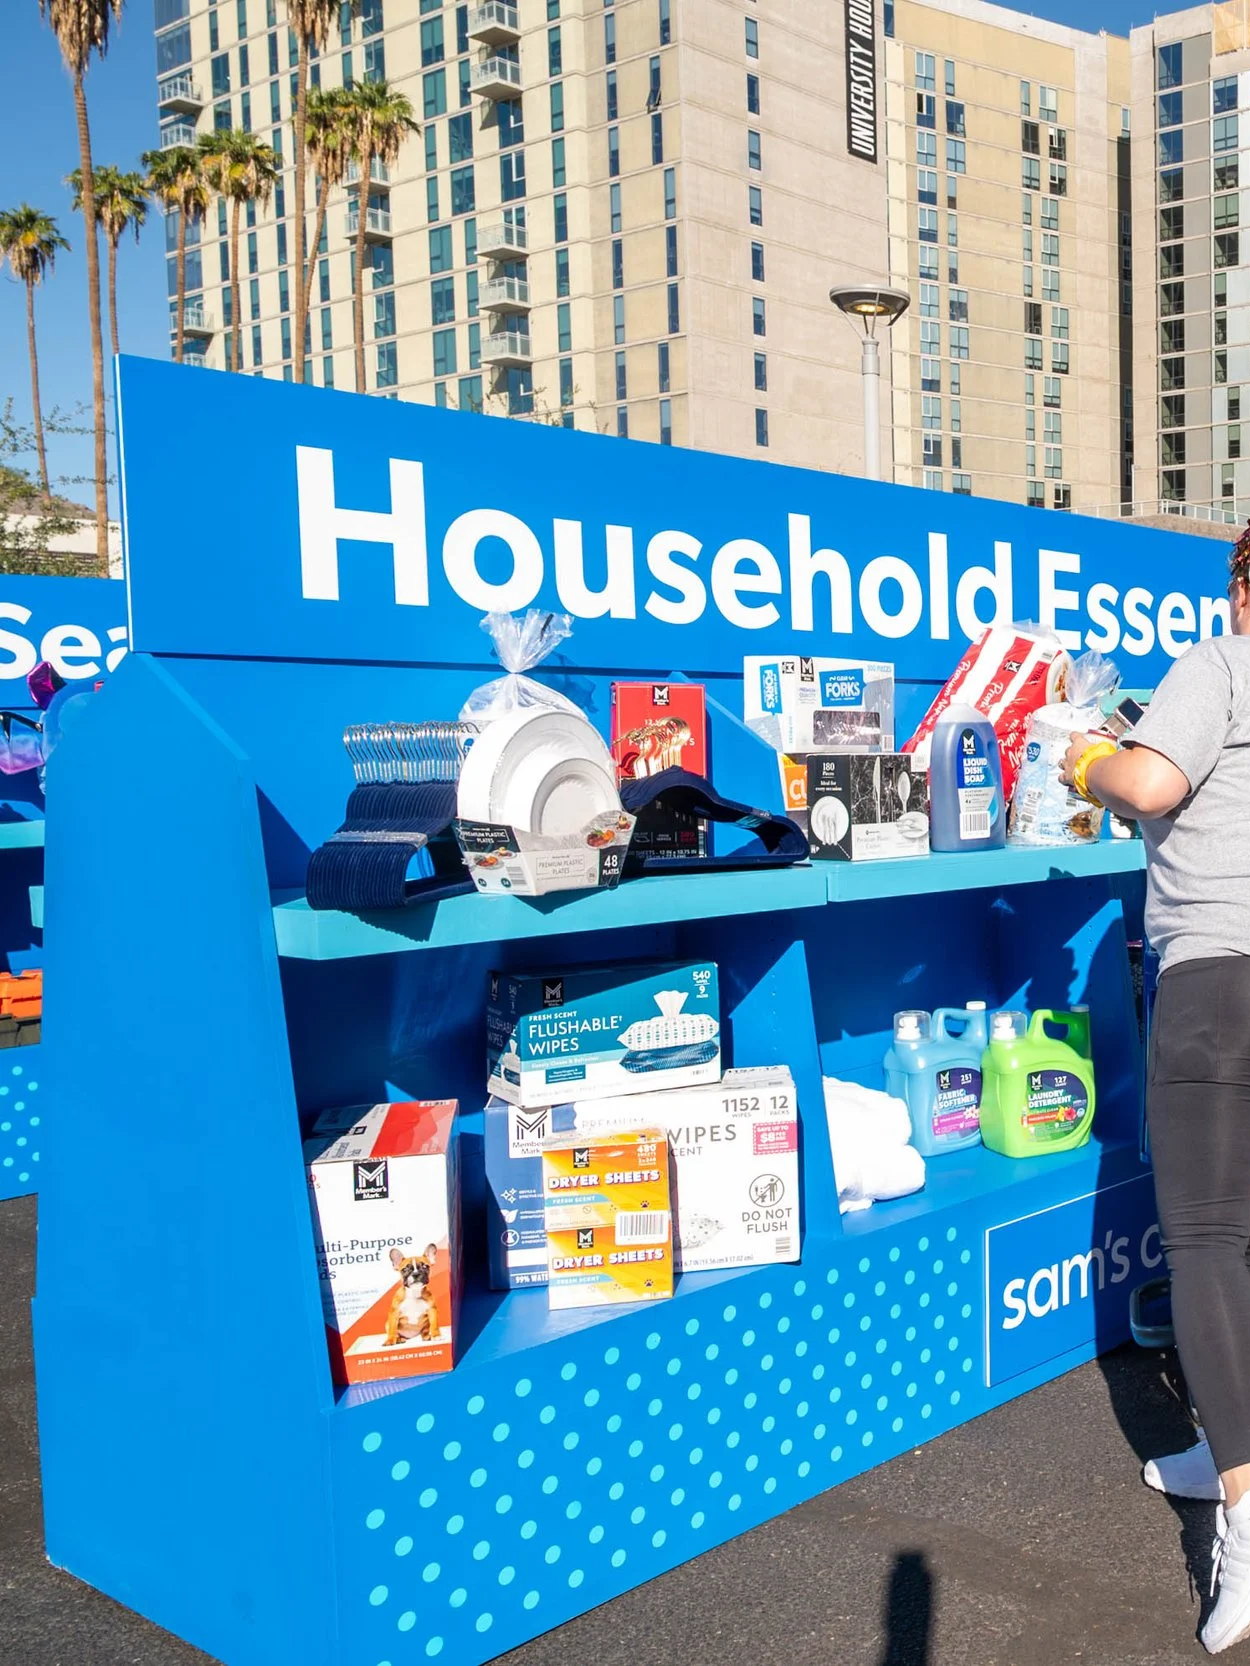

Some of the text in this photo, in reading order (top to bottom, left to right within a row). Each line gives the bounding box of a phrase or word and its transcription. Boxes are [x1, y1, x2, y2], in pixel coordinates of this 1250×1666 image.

[849, 0, 875, 156] UNIVERSITY HOU
[296, 445, 1012, 641] Household
[764, 669, 776, 709] FORKS
[826, 682, 860, 698] FORKS
[822, 762, 836, 772] 180
[963, 758, 988, 766] LIQUID
[964, 766, 983, 774] DISH
[964, 774, 985, 784] SOAP
[604, 854, 618, 868] 48
[692, 970, 711, 980] 540
[699, 985, 706, 994] 9
[528, 1010, 578, 1022] FRESH SCENT
[528, 1038, 579, 1056] WIPES
[938, 1089, 966, 1102] FABRIC
[1028, 1089, 1064, 1100] LAUNDRY
[722, 1096, 788, 1112] 1152 12
[938, 1094, 976, 1109] SOFTENER
[1028, 1095, 1072, 1108] DETERGENT
[760, 1132, 776, 1143] $8
[637, 1144, 656, 1152] 480
[670, 1146, 702, 1157] CENT
[548, 1170, 660, 1190] DRYER SHEETS
[356, 1186, 387, 1194] Member's
[552, 1195, 596, 1205] FRESH SCENT
[742, 1208, 792, 1222] DO NOT
[746, 1221, 788, 1234] FLUSH
[316, 1236, 413, 1254] ulti-Purpose
[316, 1252, 382, 1268] sorbent
[552, 1248, 664, 1271] DRYER SHEETS
[516, 1275, 530, 1284] 99%
[578, 1275, 600, 1284] SCENT
[1002, 1229, 1130, 1330] sam's
